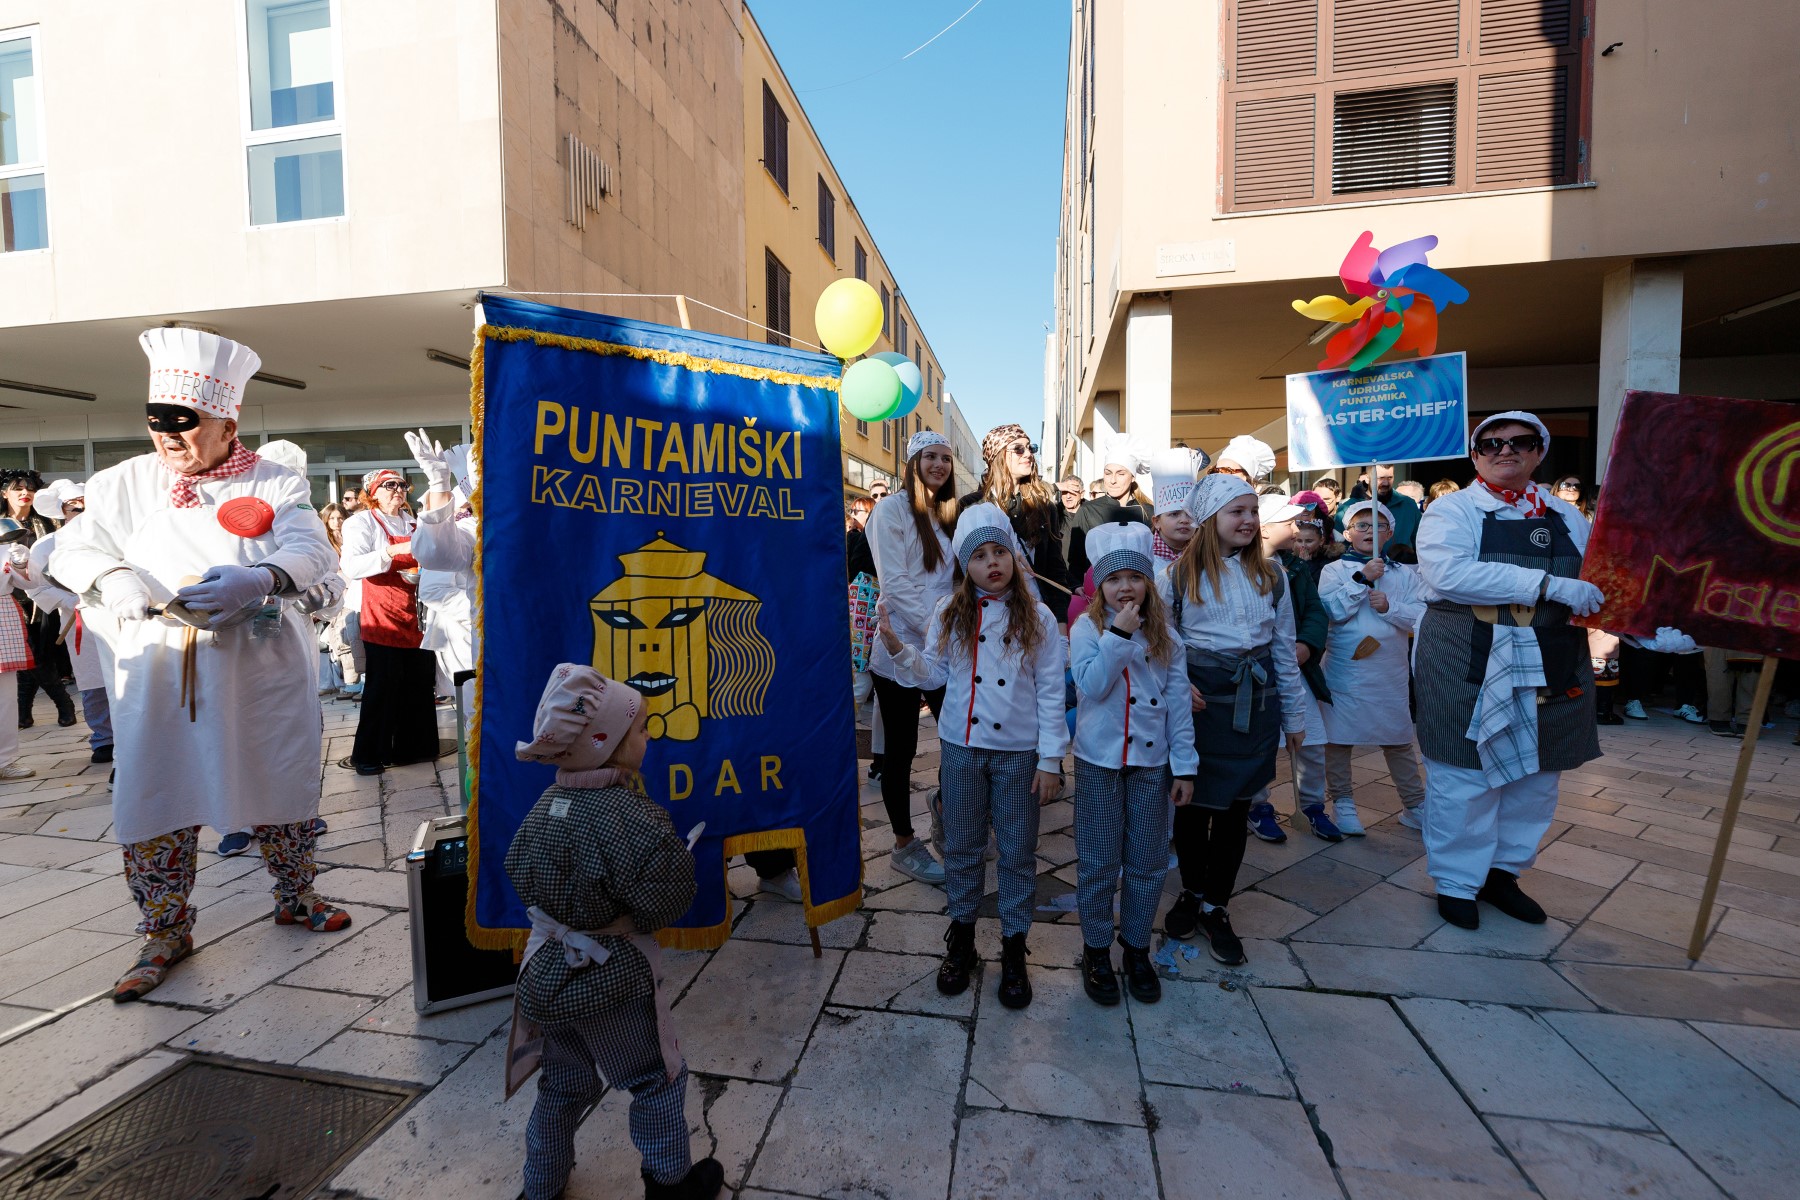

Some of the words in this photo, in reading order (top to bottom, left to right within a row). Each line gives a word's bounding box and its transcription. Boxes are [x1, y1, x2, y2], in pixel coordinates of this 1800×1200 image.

[154, 374, 236, 409] ASTERCHEF
[1332, 370, 1415, 388] KARNEVALSKA
[1348, 383, 1398, 396] UDRUGA
[1339, 391, 1407, 407] PUNTAMIKA
[534, 400, 802, 480] PUNTAMIŠKI
[531, 465, 805, 520] KARNEVAL
